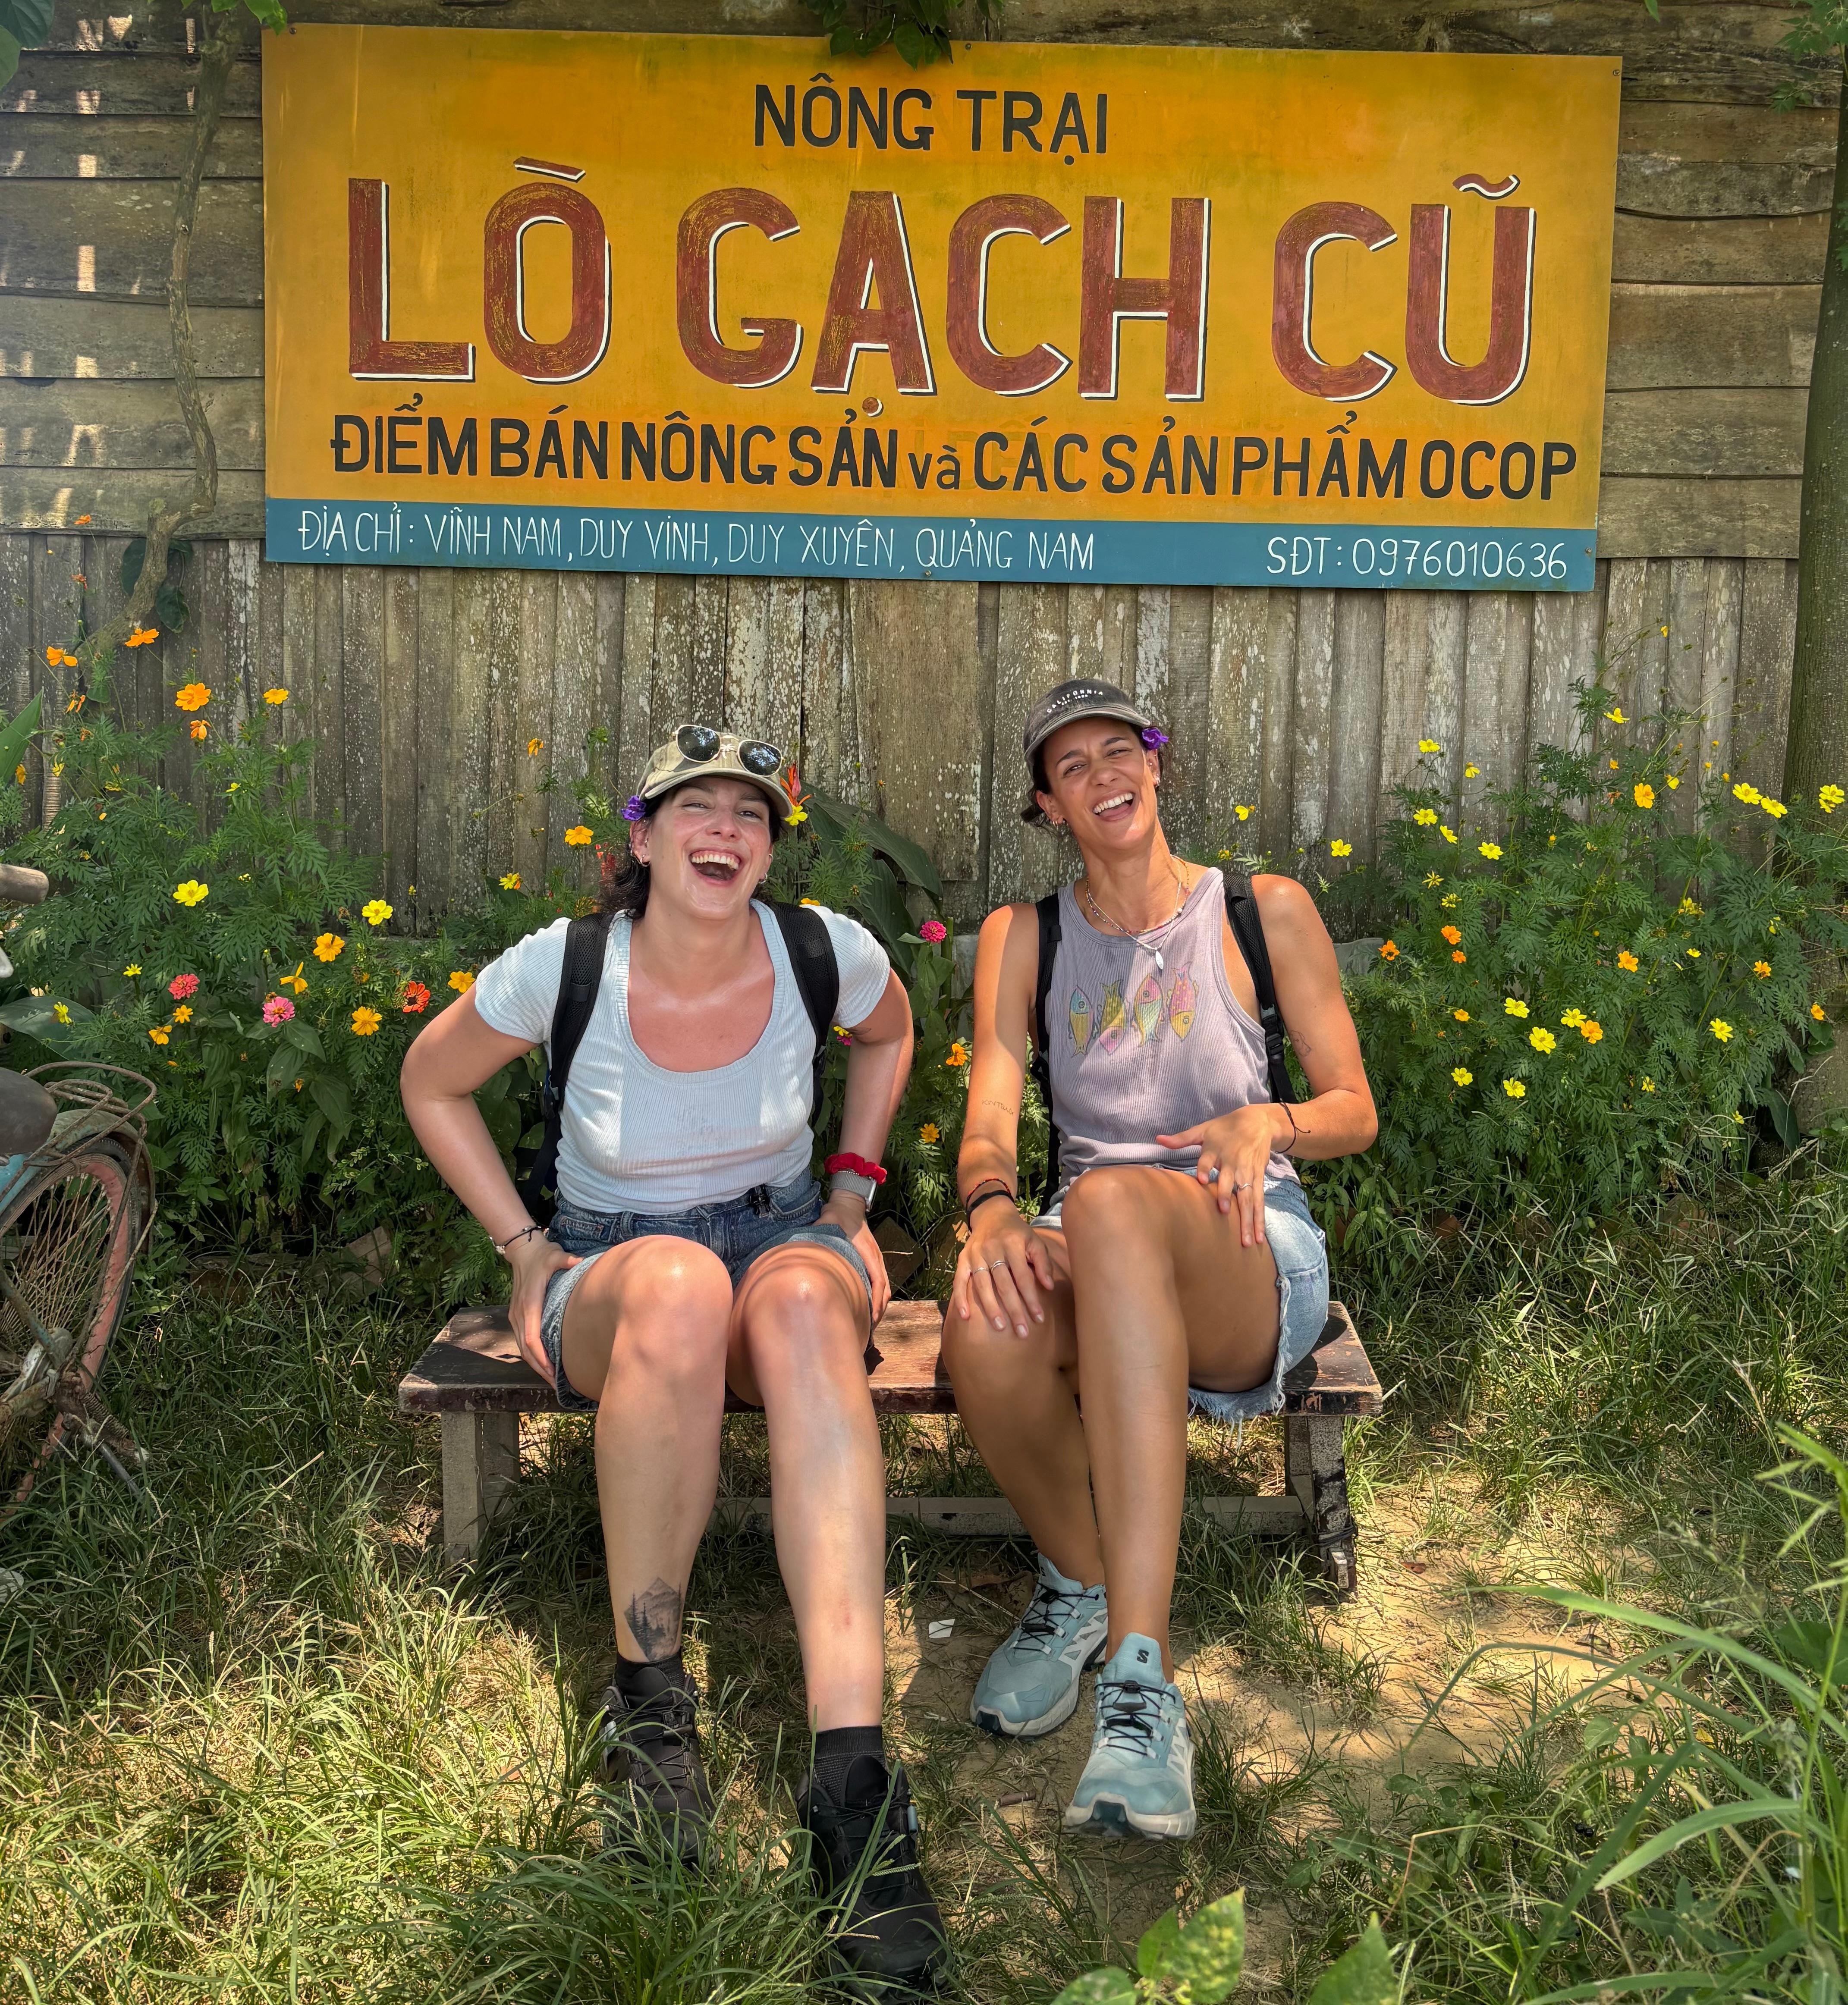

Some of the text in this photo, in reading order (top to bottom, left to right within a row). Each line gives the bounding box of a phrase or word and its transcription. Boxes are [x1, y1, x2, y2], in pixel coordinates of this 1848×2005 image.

[755, 73, 1107, 165] NÔNG TRẠI
[349, 157, 1537, 414] LÒ GẠCH CŨ
[330, 393, 1576, 500] ĐIỂM BÁN NÔNG SẢN và CÁC SẢN PHẨM OCOP
[298, 506, 347, 555] ĐỊA
[425, 507, 490, 555] VĨNH
[504, 517, 572, 562] NAM,
[581, 519, 632, 558] DUY
[729, 524, 784, 563] DUY
[800, 519, 904, 572] XUYÊN,
[916, 519, 1012, 568] QUẢNG
[1029, 532, 1093, 570] NAM
[1353, 539, 1566, 578] 0976010636
